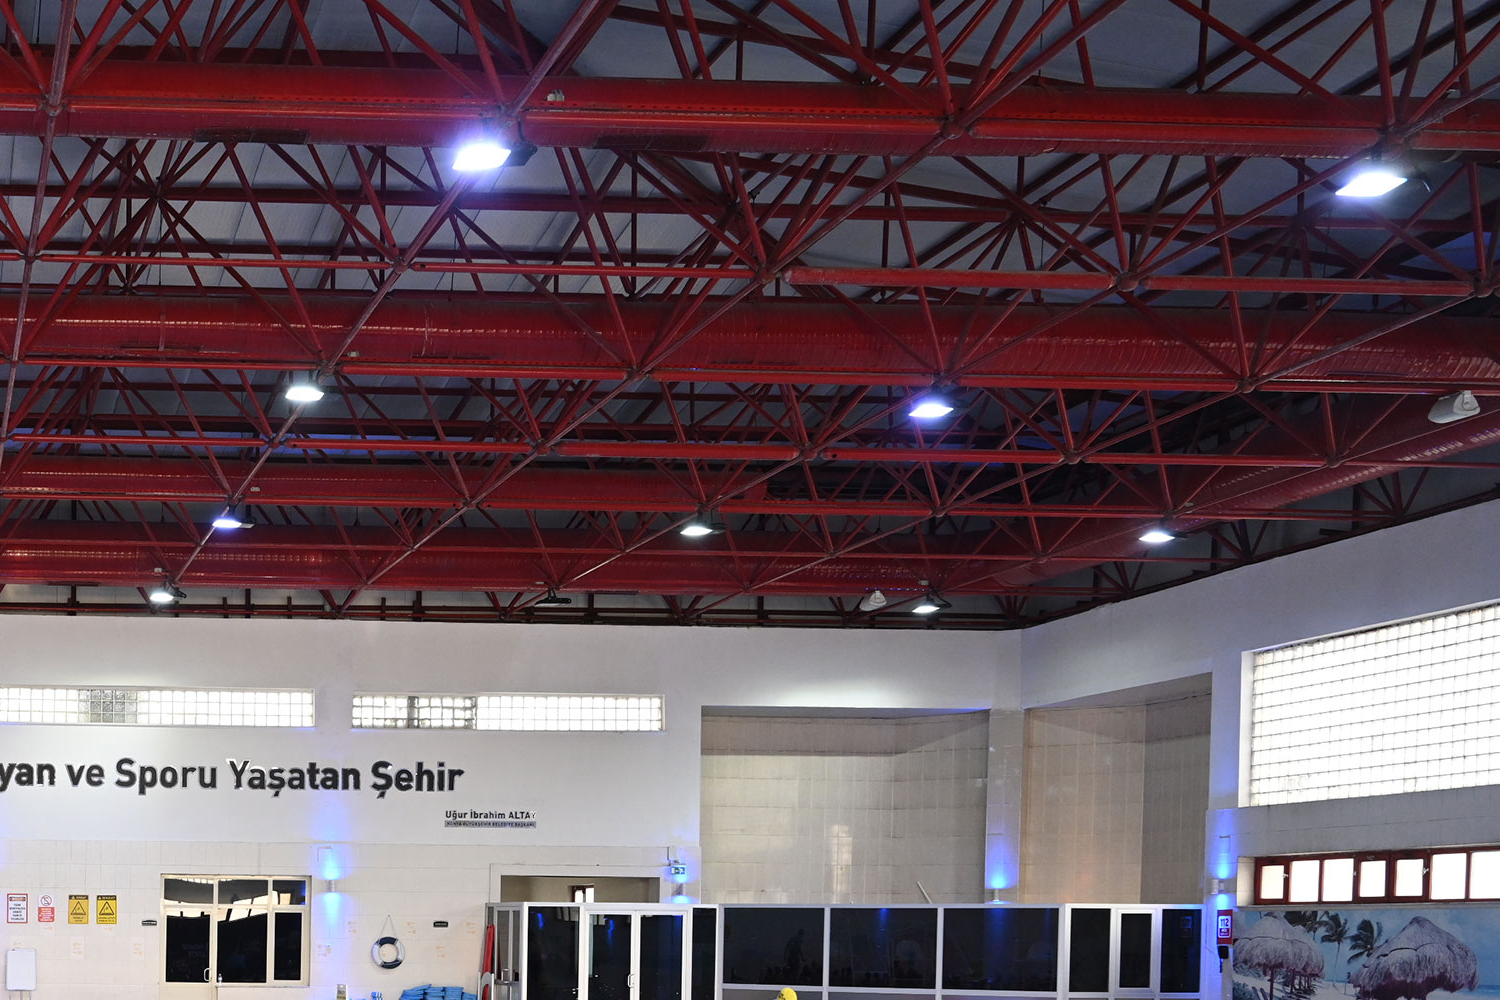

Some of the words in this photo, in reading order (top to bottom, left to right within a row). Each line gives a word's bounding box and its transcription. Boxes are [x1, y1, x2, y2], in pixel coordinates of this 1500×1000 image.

[65, 763, 105, 787] ve
[115, 757, 218, 796] Sporu
[226, 758, 361, 798] Yaşatan
[371, 760, 465, 799] Şehir
[445, 810, 468, 820] Uğur
[470, 808, 506, 819] İbrahim
[508, 811, 536, 819] ALTAY
